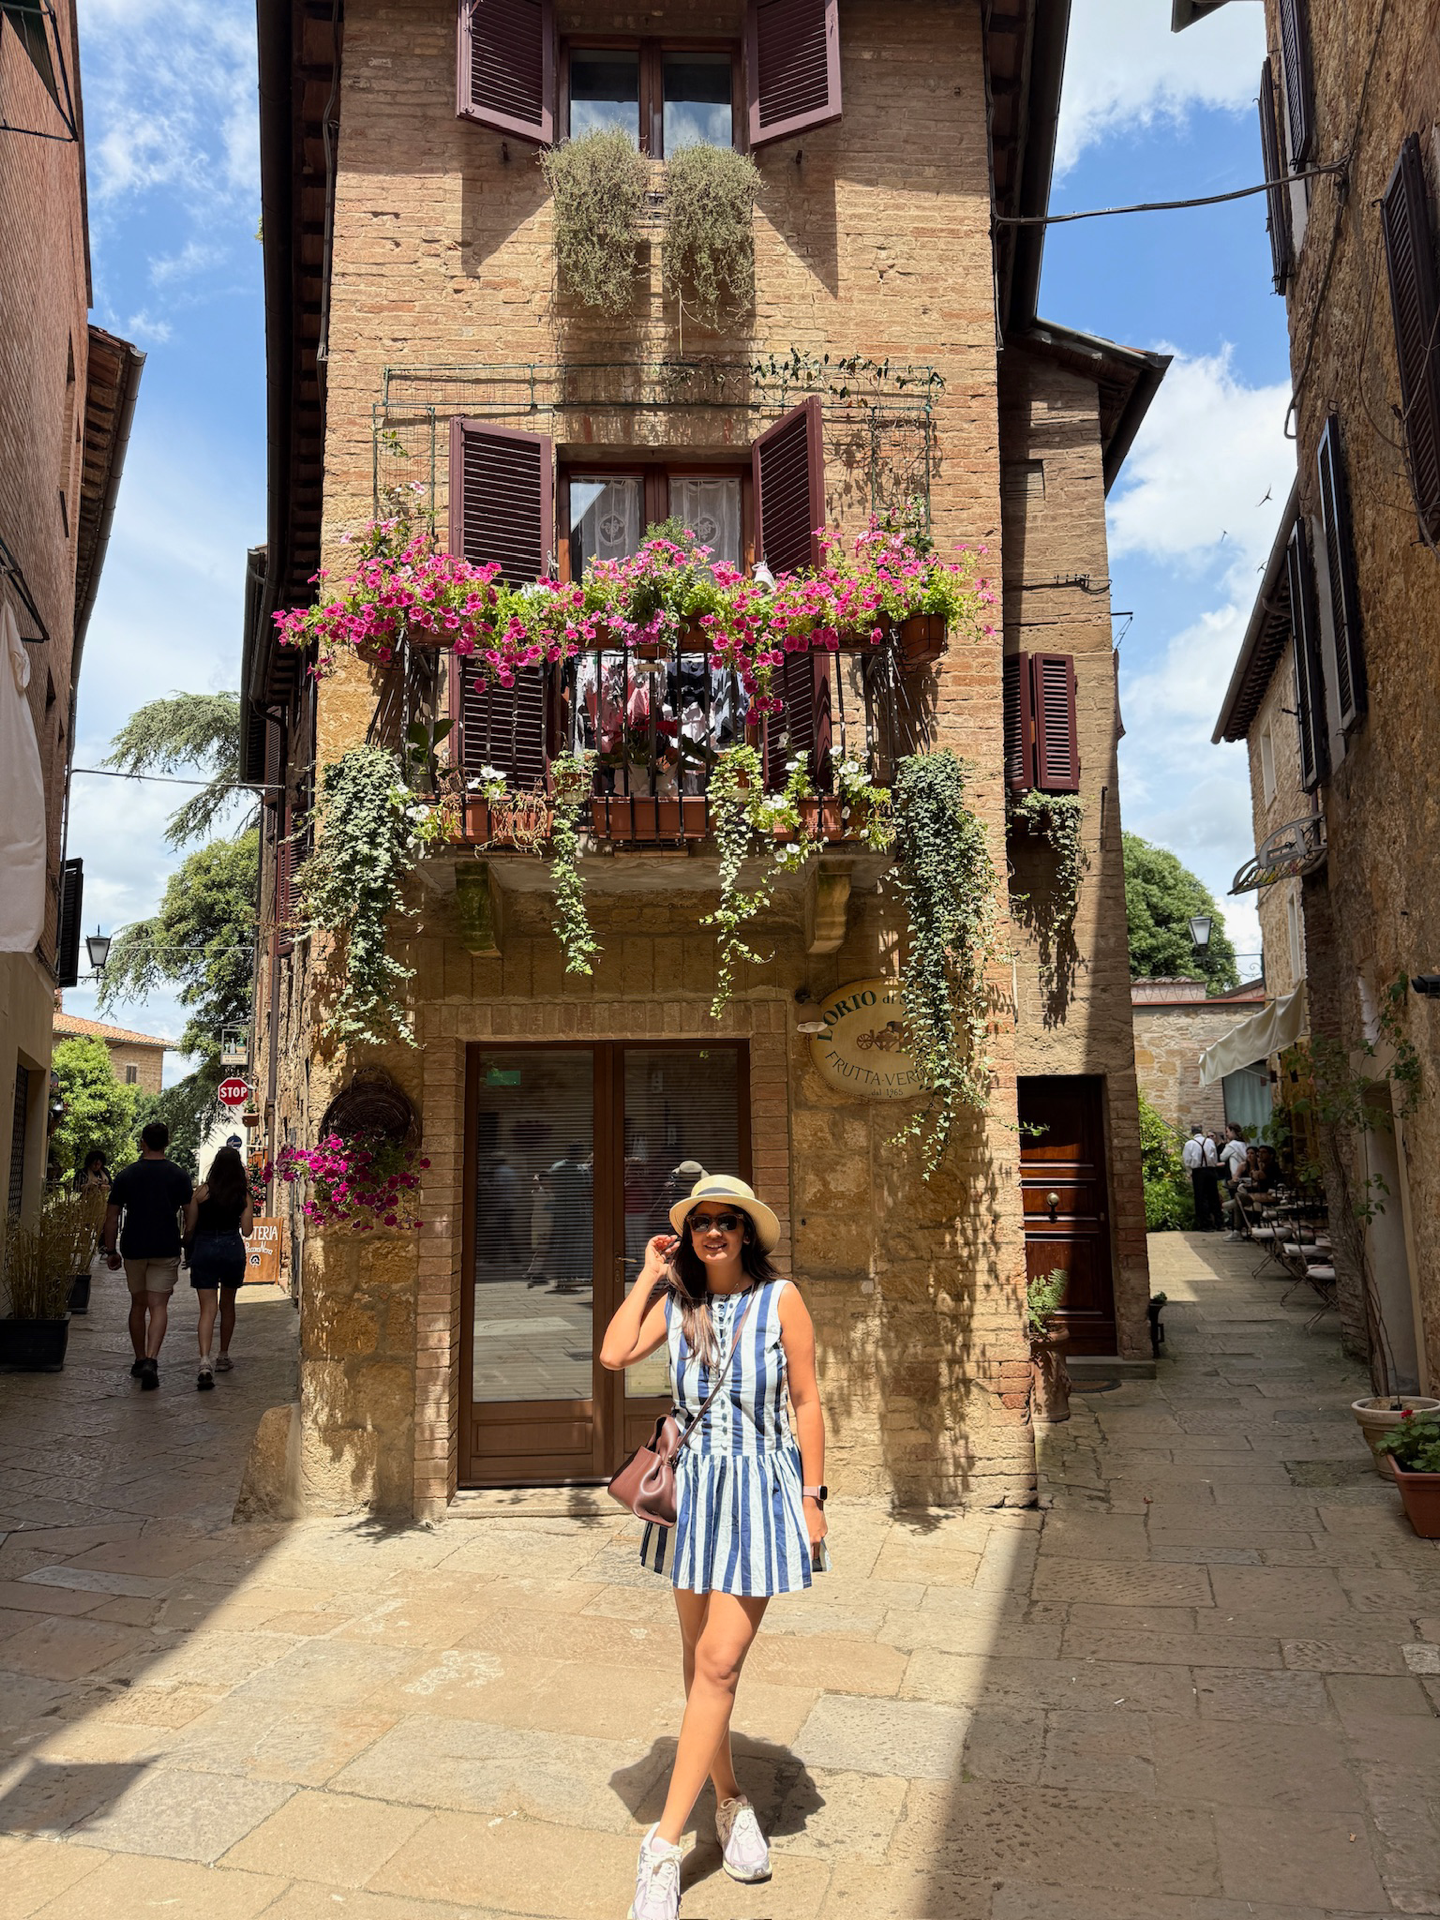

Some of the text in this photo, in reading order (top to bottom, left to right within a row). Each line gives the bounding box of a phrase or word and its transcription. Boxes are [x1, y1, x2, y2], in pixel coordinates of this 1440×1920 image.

[817, 990, 877, 1042] LORTO
[220, 1086, 247, 1098] STOP
[871, 1088, 904, 1097] dal 1965
[239, 1225, 278, 1241] TERIA
